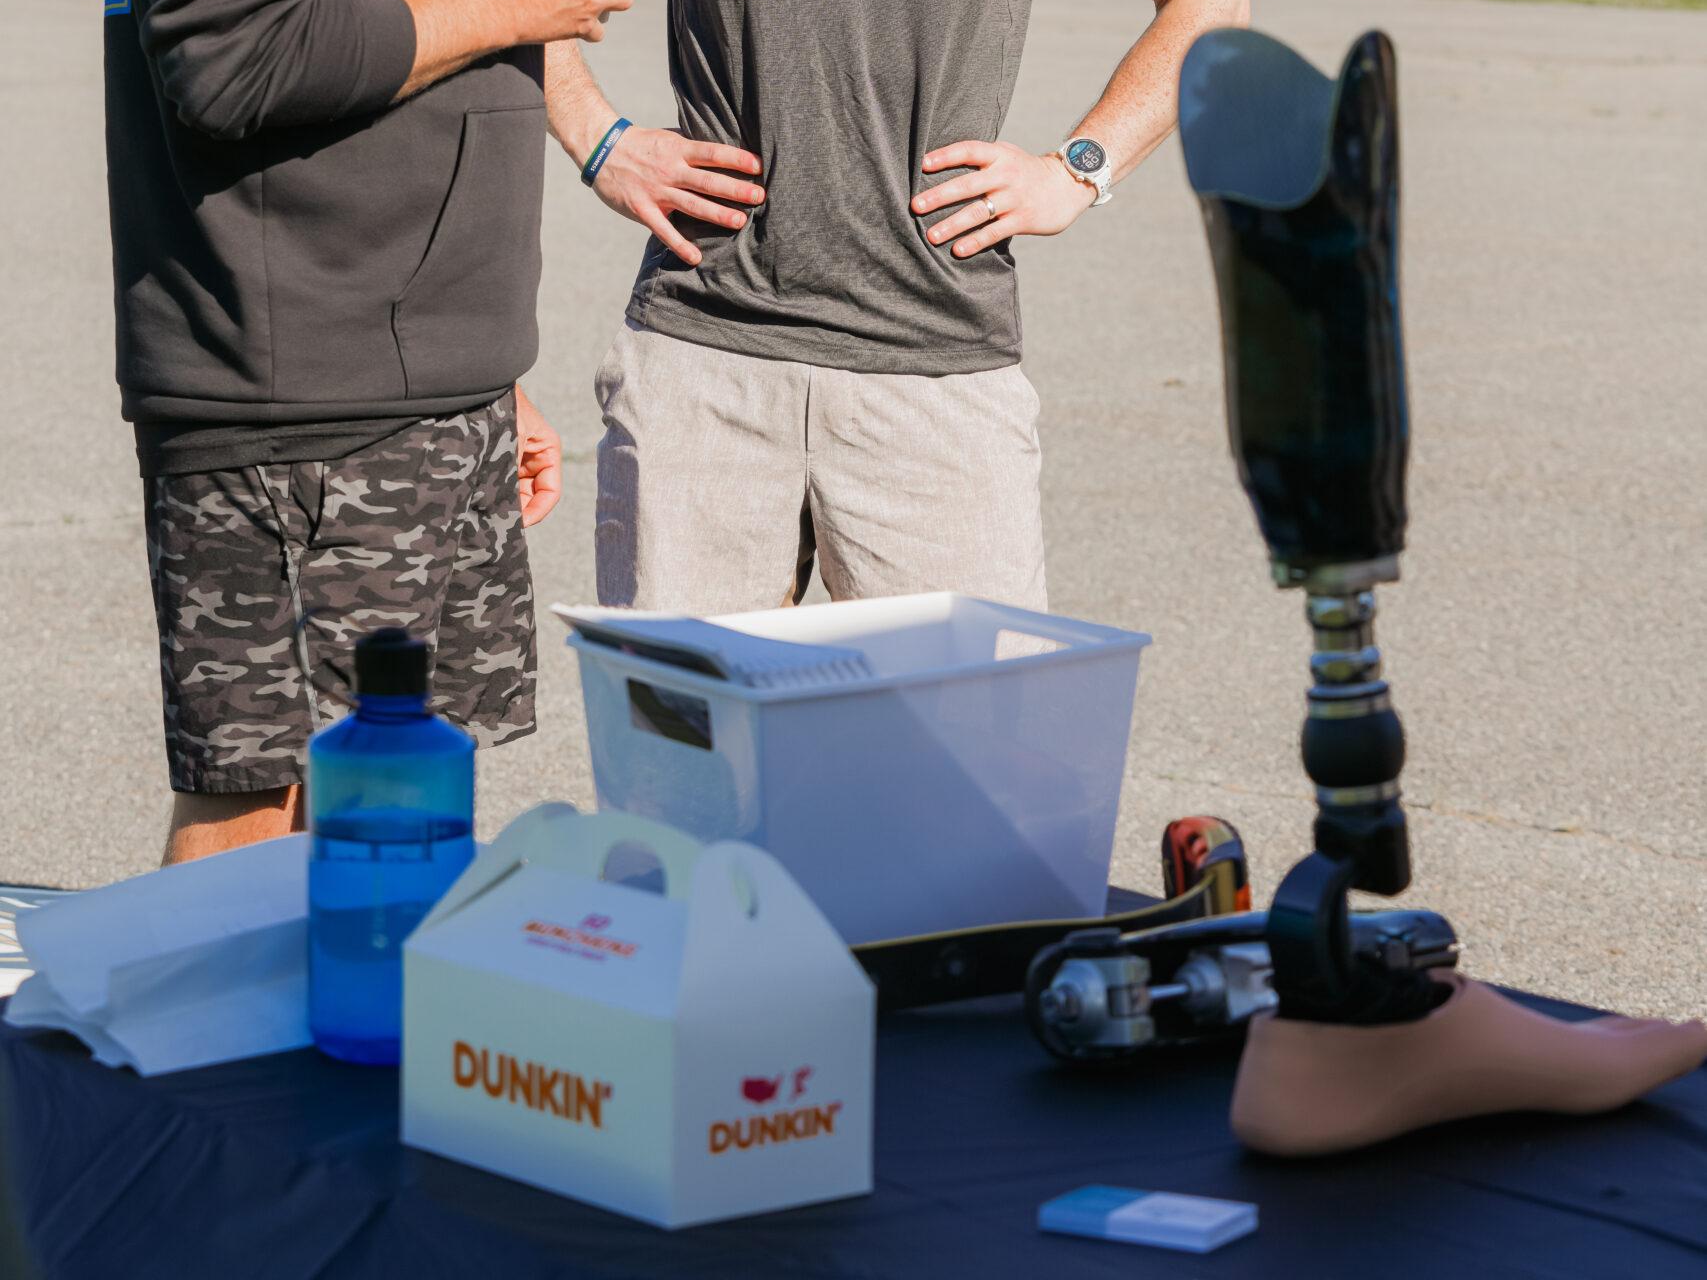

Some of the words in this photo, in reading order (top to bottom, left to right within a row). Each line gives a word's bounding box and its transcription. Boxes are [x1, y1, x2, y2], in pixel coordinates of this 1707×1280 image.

[590, 147, 607, 172] KINDNESS
[453, 1040, 613, 1129] DUNKIN'
[708, 1102, 843, 1155] DUNKIN'
